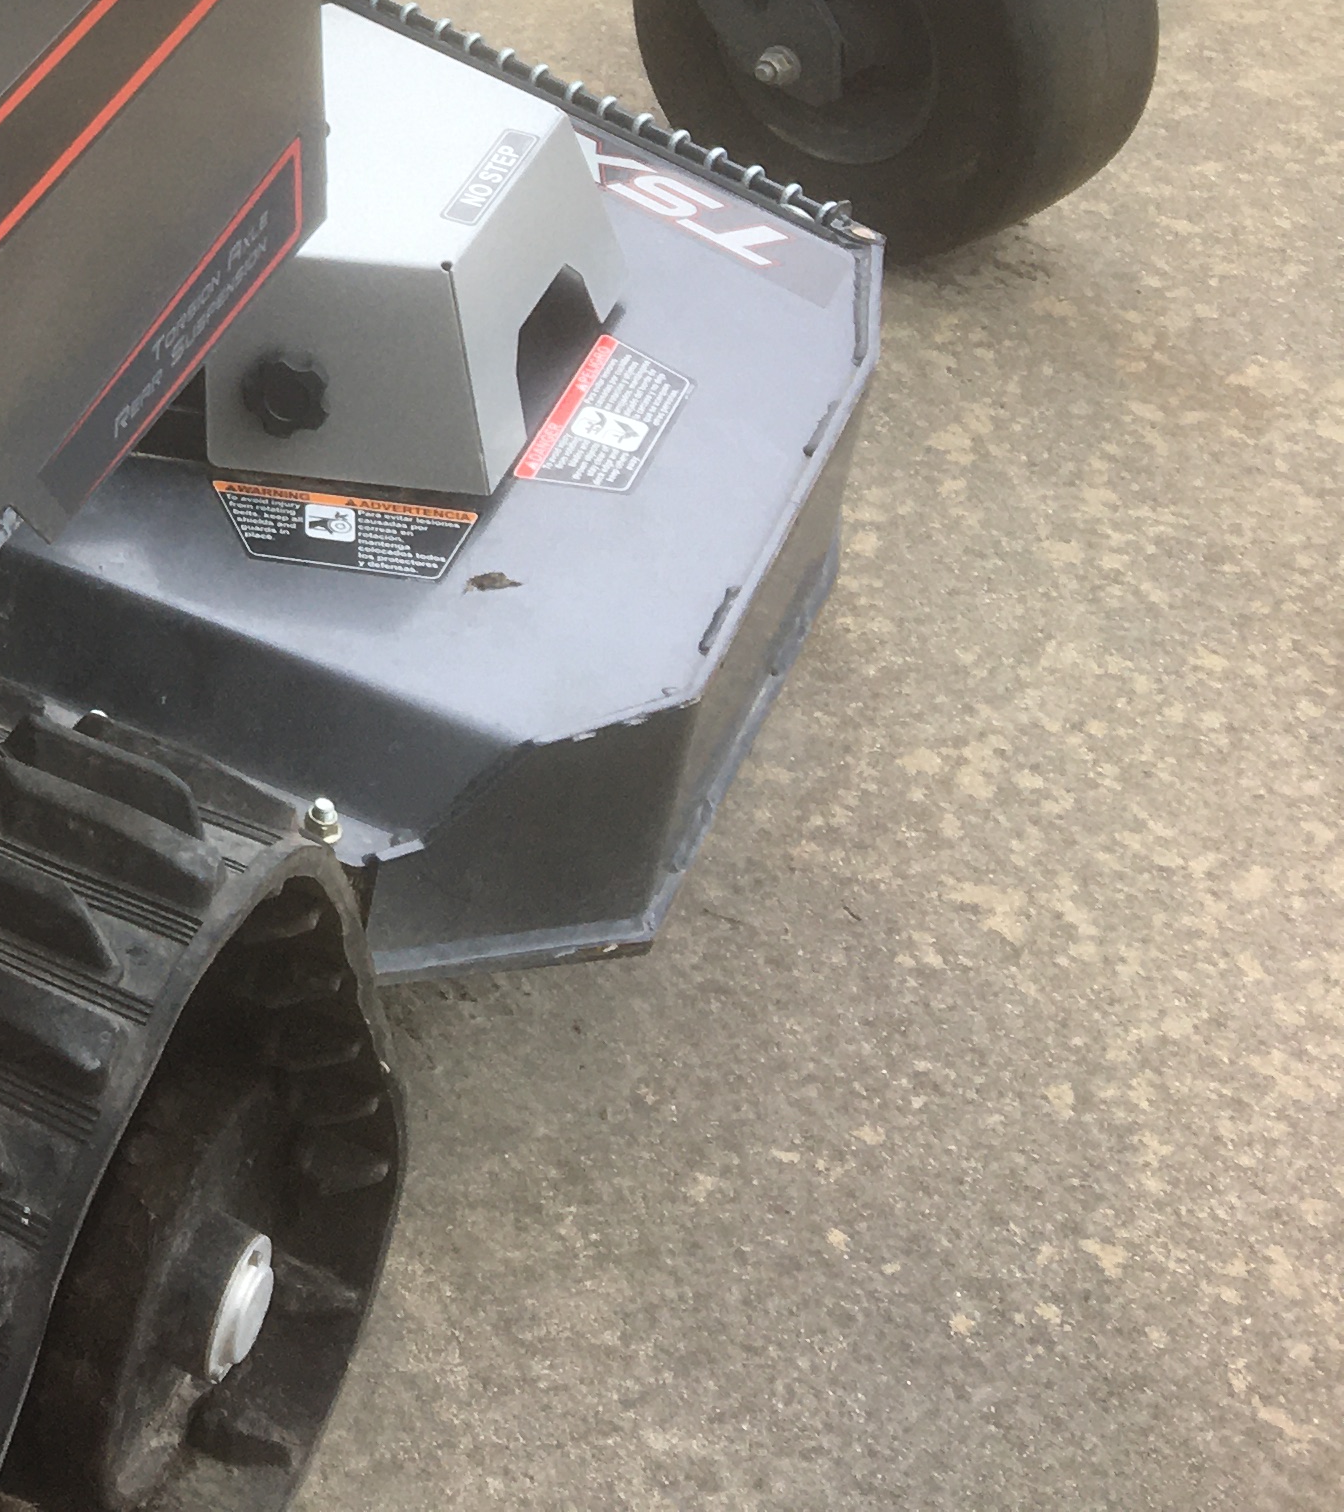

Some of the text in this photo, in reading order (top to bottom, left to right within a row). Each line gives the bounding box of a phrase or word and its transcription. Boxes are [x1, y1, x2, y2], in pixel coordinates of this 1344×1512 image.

[462, 144, 521, 209] NO STEP
[581, 345, 611, 389] PELIGRO
[531, 422, 563, 467] DANGER
[237, 484, 310, 502] WARNING
[360, 500, 470, 521] ADVERTENCIA
